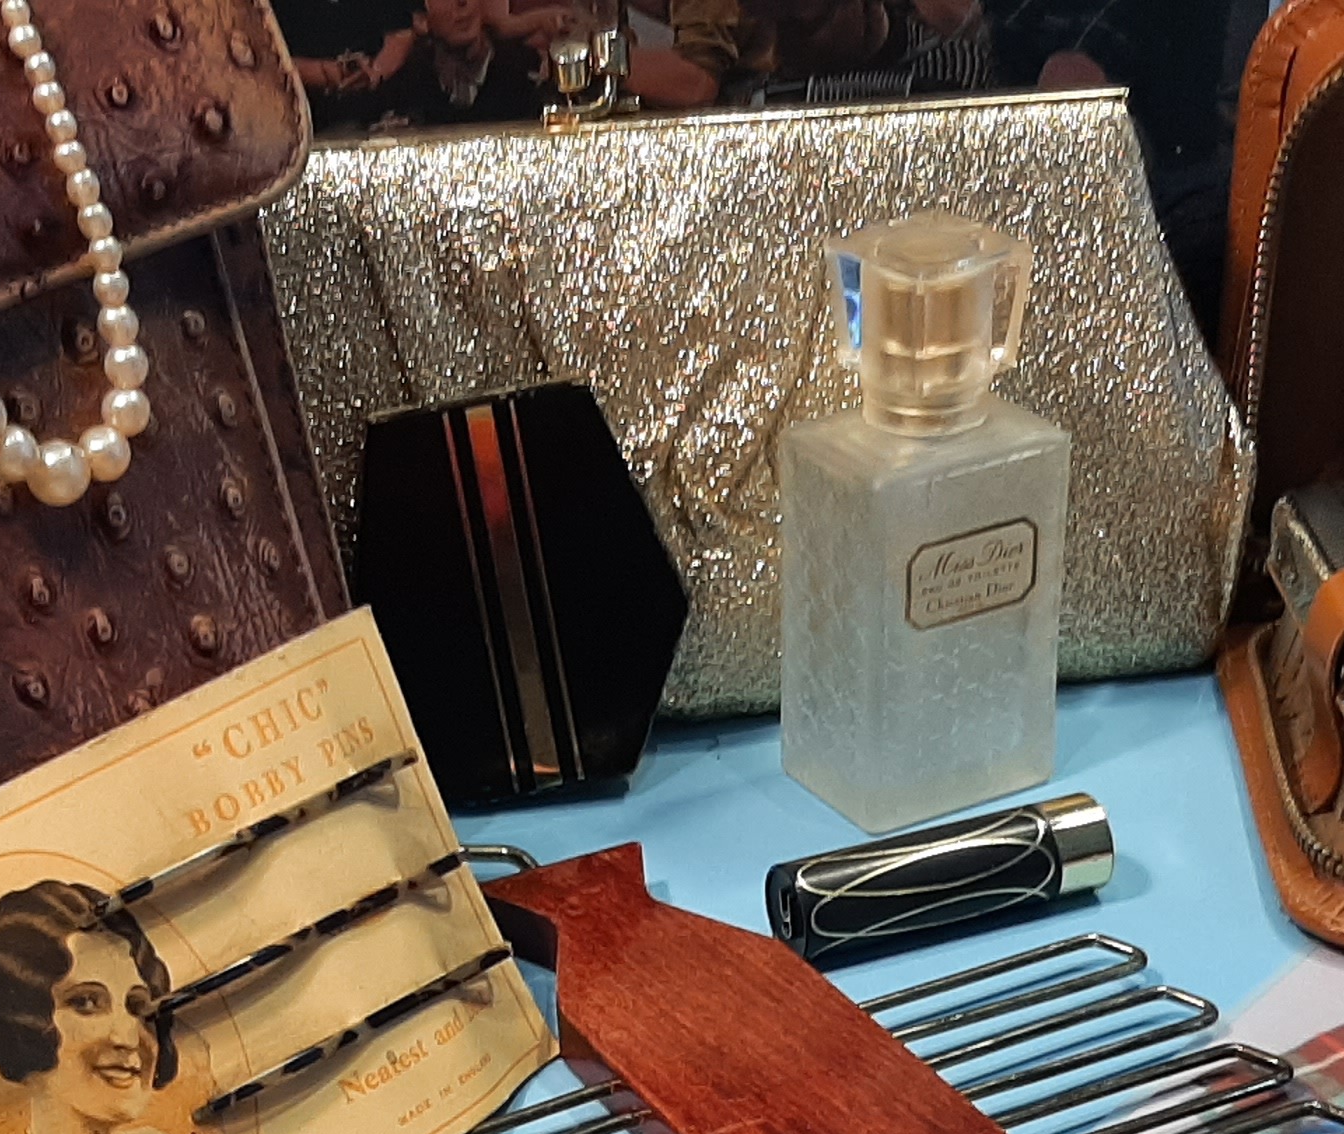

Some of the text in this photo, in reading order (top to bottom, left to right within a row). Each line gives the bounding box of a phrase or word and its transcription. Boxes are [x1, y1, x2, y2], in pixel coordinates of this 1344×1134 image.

[976, 540, 1024, 566] Dior
[186, 716, 375, 838] BOBBY PINS
[338, 1006, 465, 1104] Neatest and
